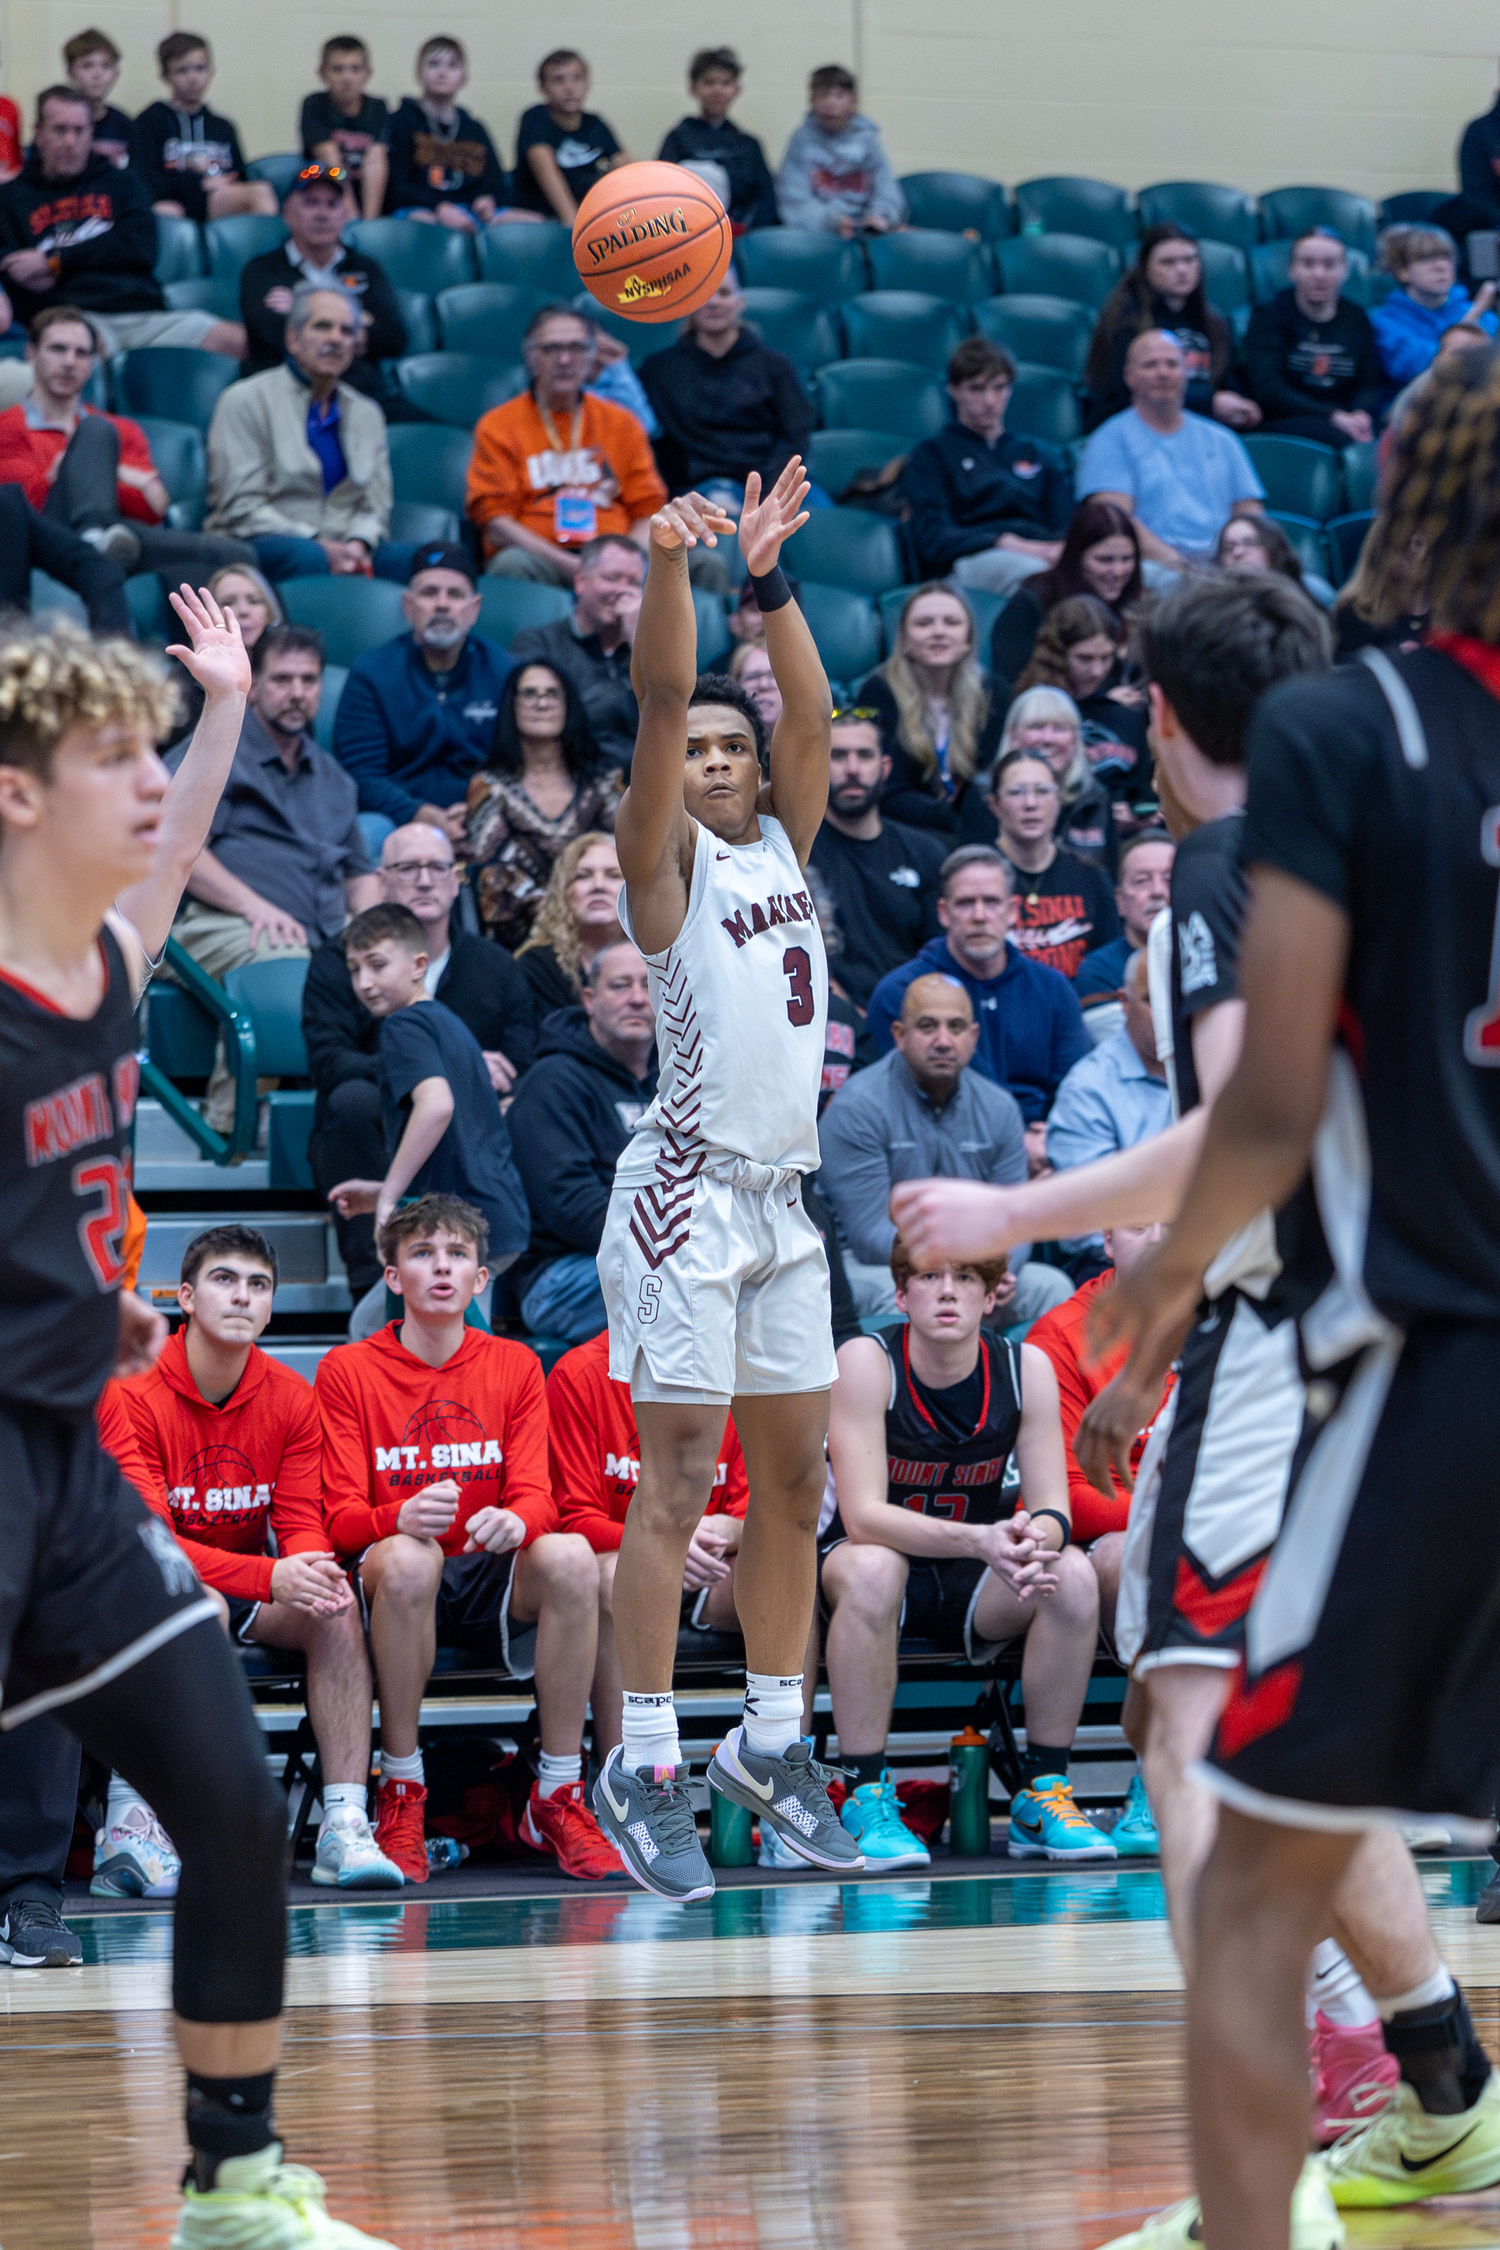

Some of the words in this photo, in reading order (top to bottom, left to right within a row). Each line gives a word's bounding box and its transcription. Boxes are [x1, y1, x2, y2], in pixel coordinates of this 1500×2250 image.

[587, 207, 688, 266] SPALDING
[624, 262, 692, 299] NYSPHSAA
[782, 945, 815, 1028] 3
[637, 1274, 663, 1325] S
[374, 1445, 427, 1472] MT.
[431, 1439, 503, 1469] SINA
[604, 1452, 641, 1482] MT
[204, 1482, 276, 1512] SINA
